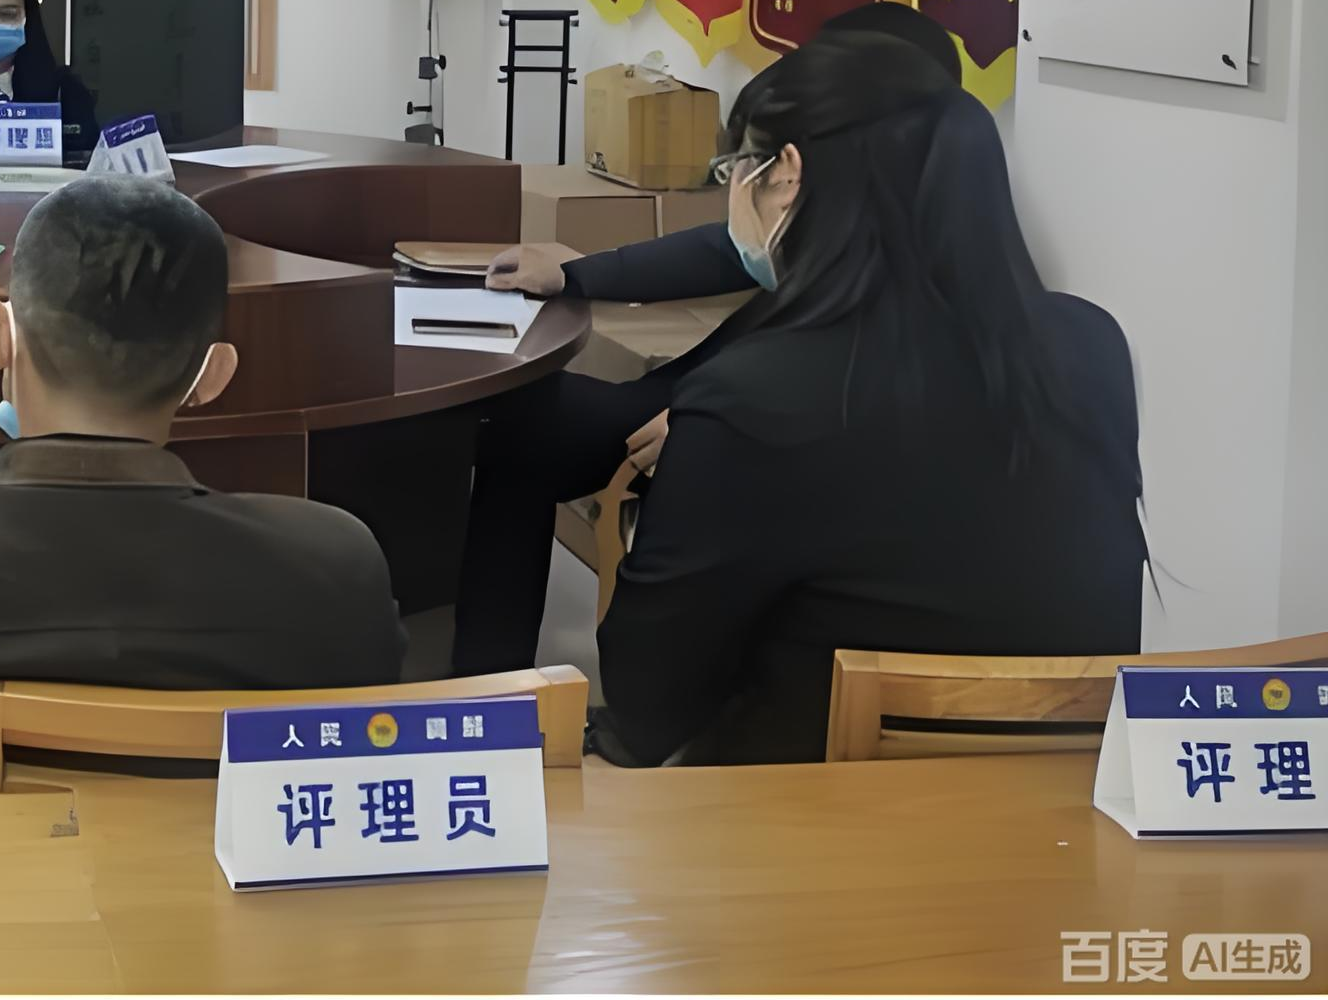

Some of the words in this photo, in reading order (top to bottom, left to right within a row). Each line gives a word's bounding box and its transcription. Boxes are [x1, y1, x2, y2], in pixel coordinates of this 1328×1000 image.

[1177, 741, 1316, 803] 评理
[277, 775, 496, 849] 评理员
